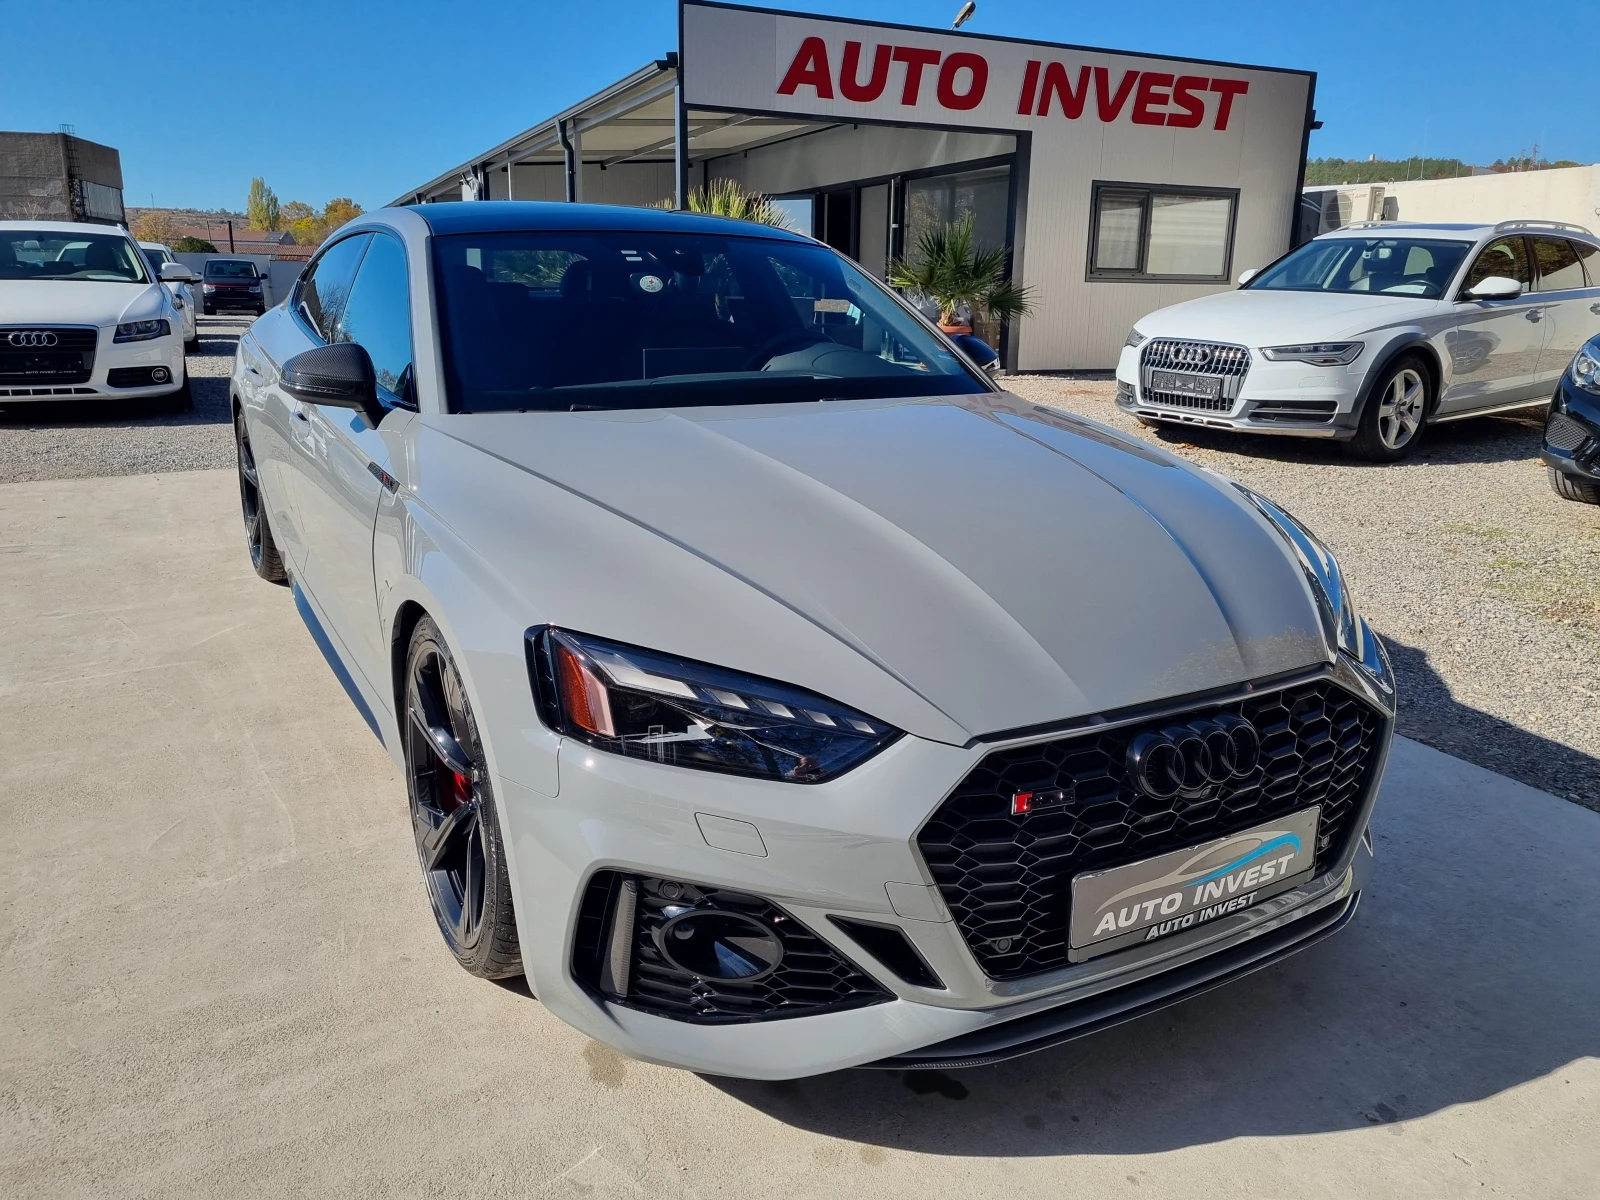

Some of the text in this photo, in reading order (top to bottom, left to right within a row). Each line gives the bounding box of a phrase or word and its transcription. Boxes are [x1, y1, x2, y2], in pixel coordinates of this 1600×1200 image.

[776, 36, 1249, 131] AUTO INVEST
[1093, 853, 1294, 936] AUTO INVEST
[1146, 892, 1257, 940] AUTO INVEST
